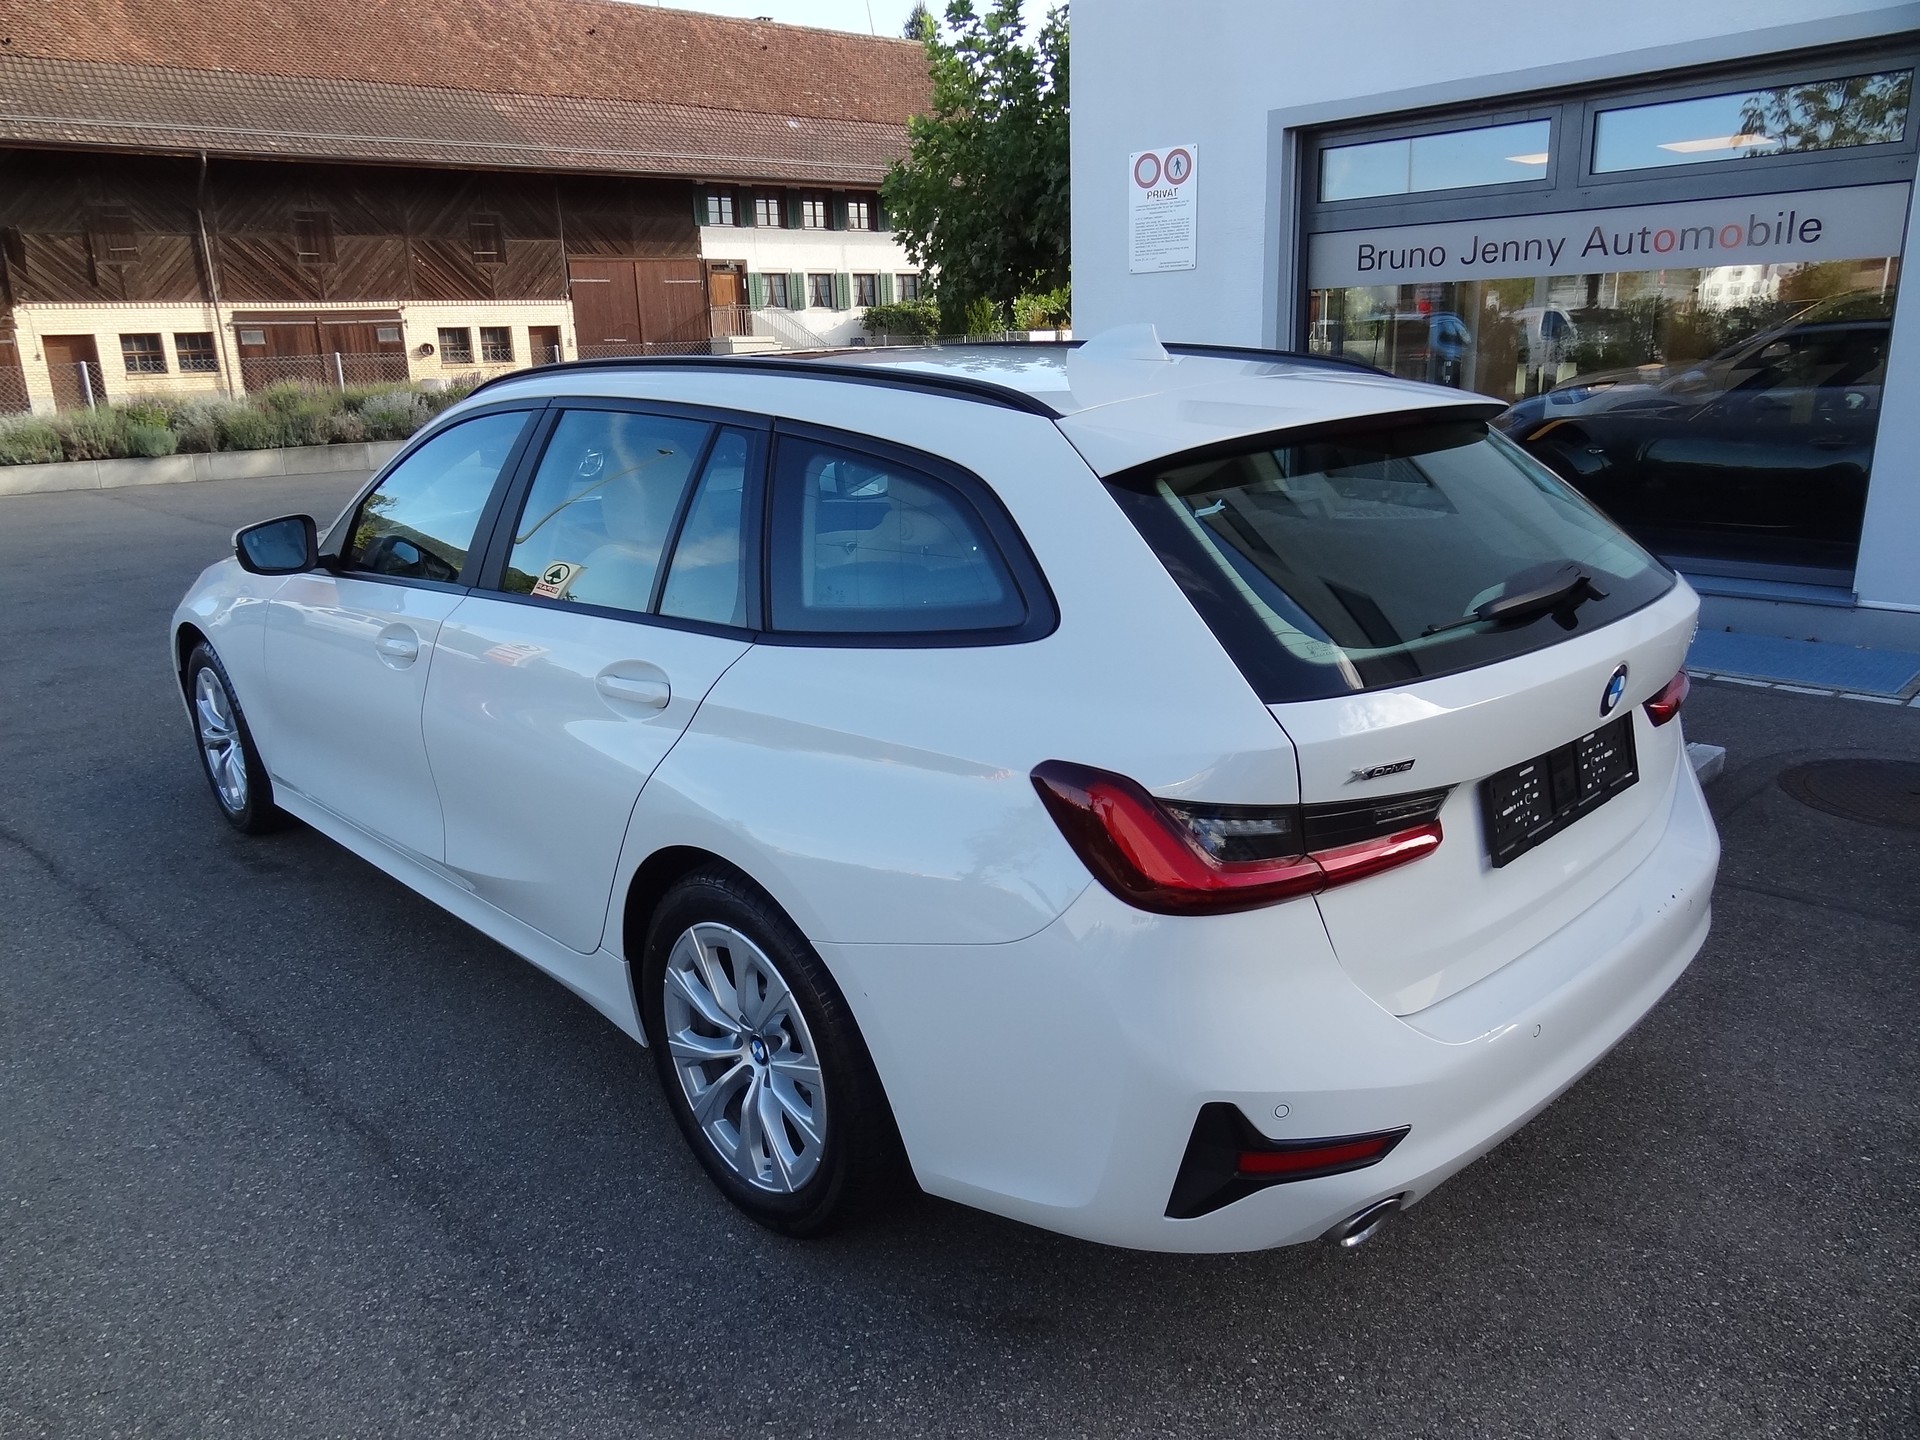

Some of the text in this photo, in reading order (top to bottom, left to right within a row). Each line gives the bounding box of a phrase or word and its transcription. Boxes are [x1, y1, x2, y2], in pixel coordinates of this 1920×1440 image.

[1147, 187, 1178, 200] PRIVAT
[1357, 210, 1822, 272] Bruno Jenny Automobile
